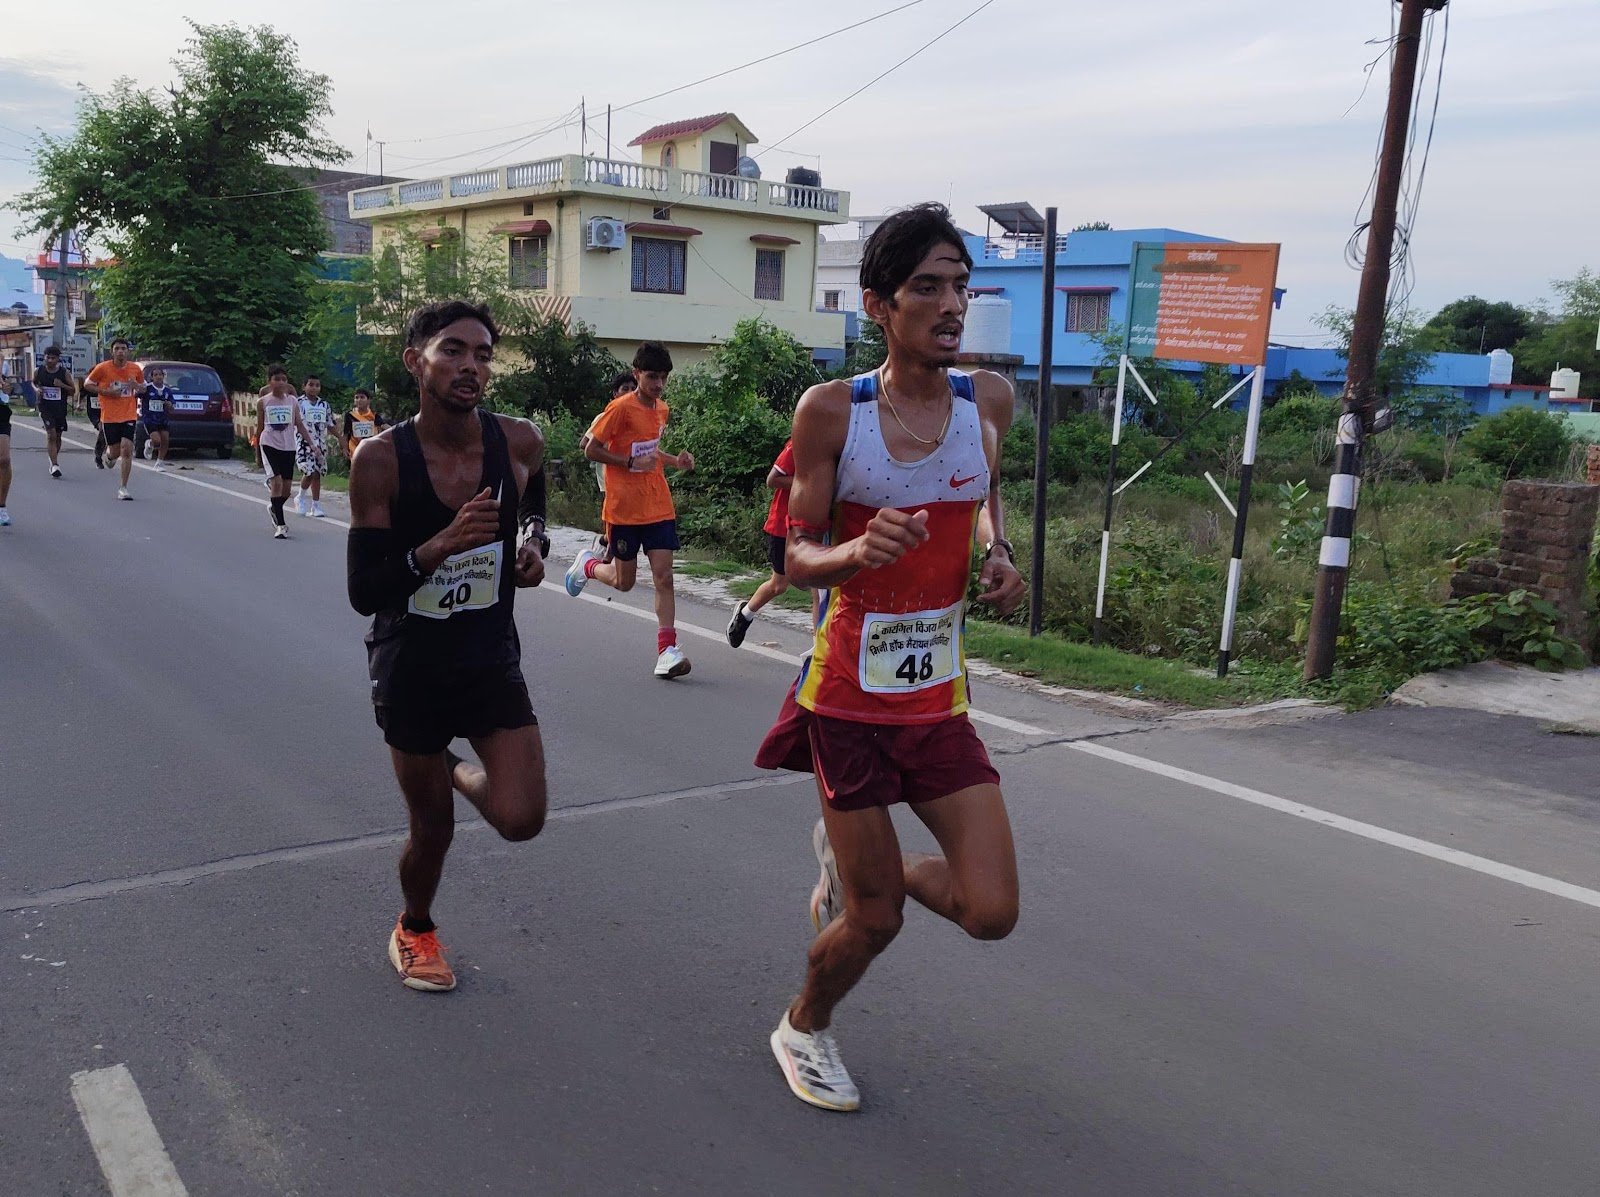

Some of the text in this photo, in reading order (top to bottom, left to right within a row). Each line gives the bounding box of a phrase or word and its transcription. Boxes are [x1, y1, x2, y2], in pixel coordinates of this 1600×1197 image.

[472, 556, 489, 567] दिवस
[438, 582, 472, 611] 40
[881, 622, 913, 635] कारगिल
[915, 620, 937, 633] विजय
[869, 641, 888, 656] मिनी
[896, 652, 933, 684] 48
